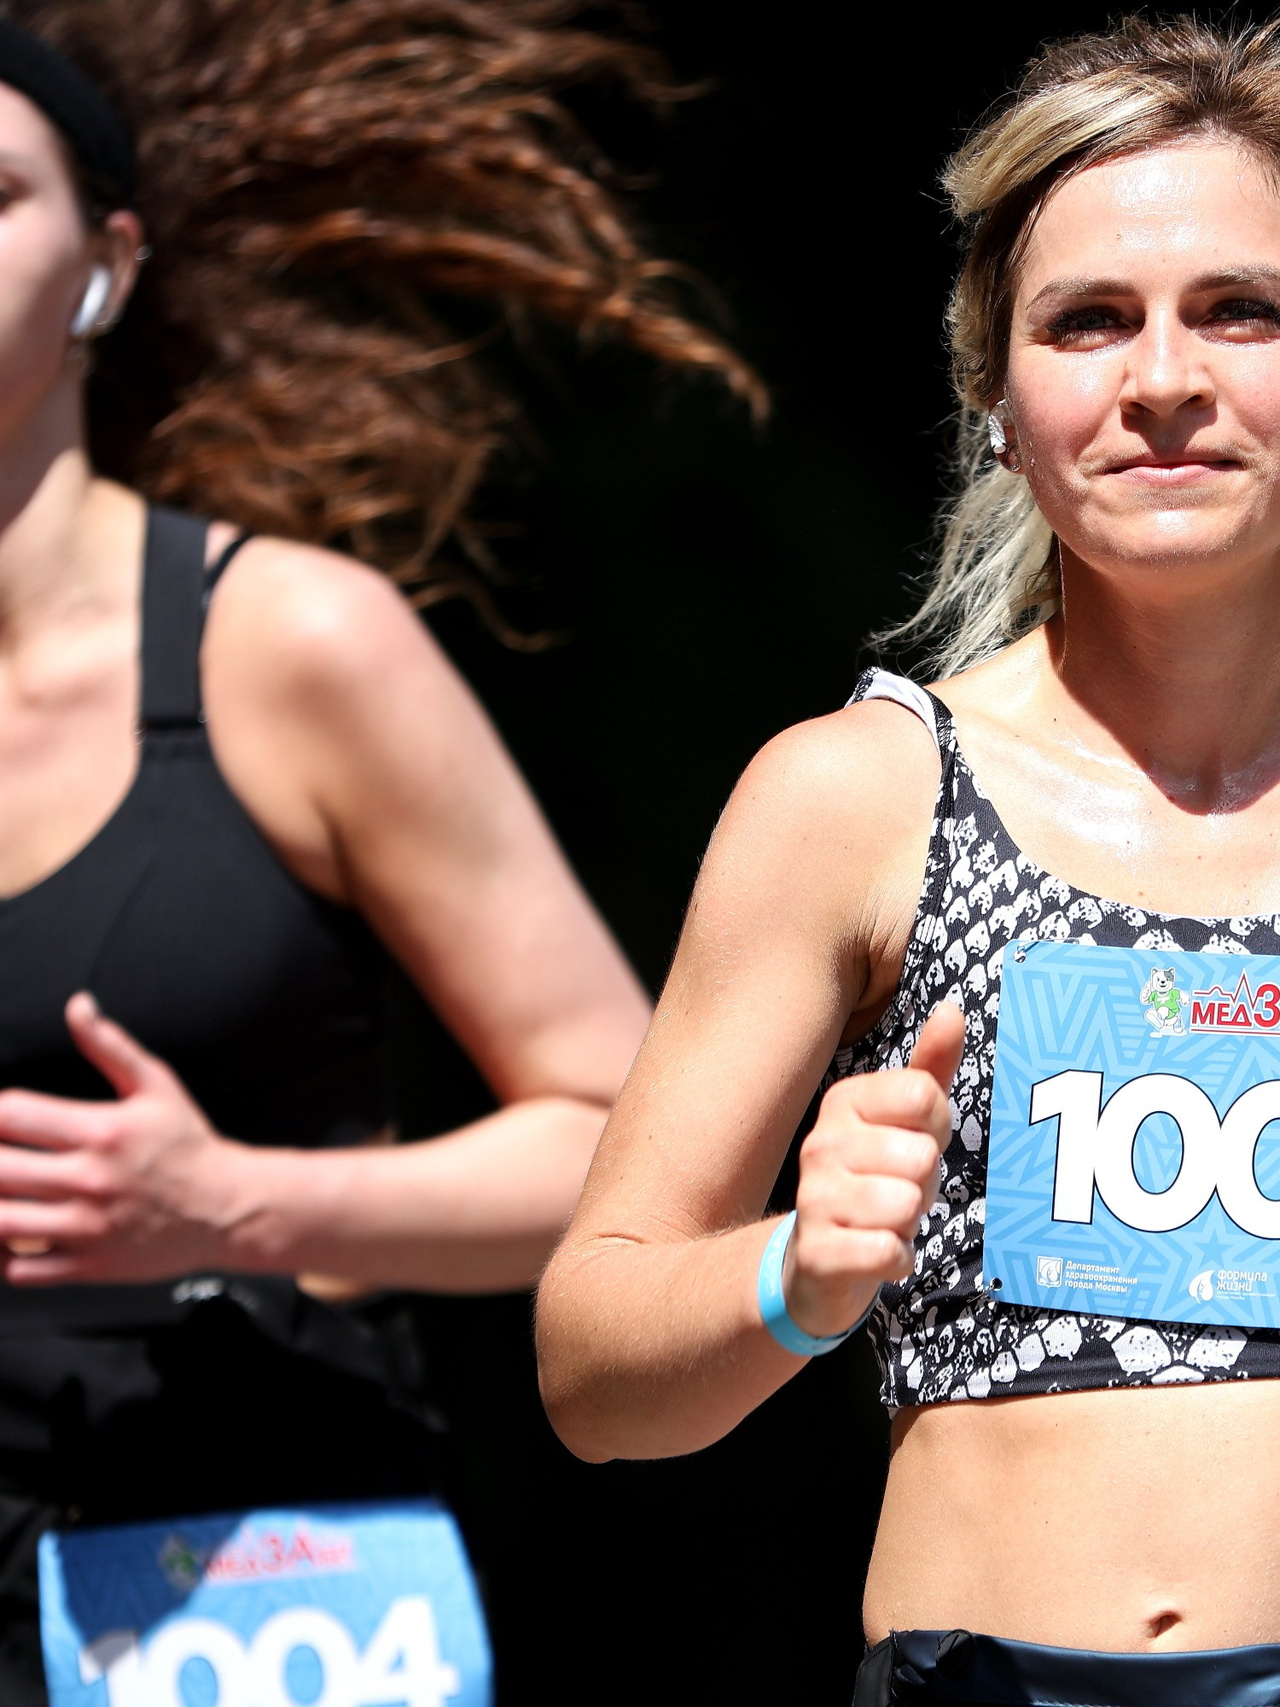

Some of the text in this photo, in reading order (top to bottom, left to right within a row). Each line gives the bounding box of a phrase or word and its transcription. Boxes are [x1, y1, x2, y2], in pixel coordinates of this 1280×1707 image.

[1065, 1260, 1120, 1274] Департамент
[1064, 1271, 1138, 1285] здравоохранения
[1064, 1280, 1128, 1293] города Москвы
[1216, 1280, 1253, 1292] жизни
[78, 1596, 460, 1707] 1004
